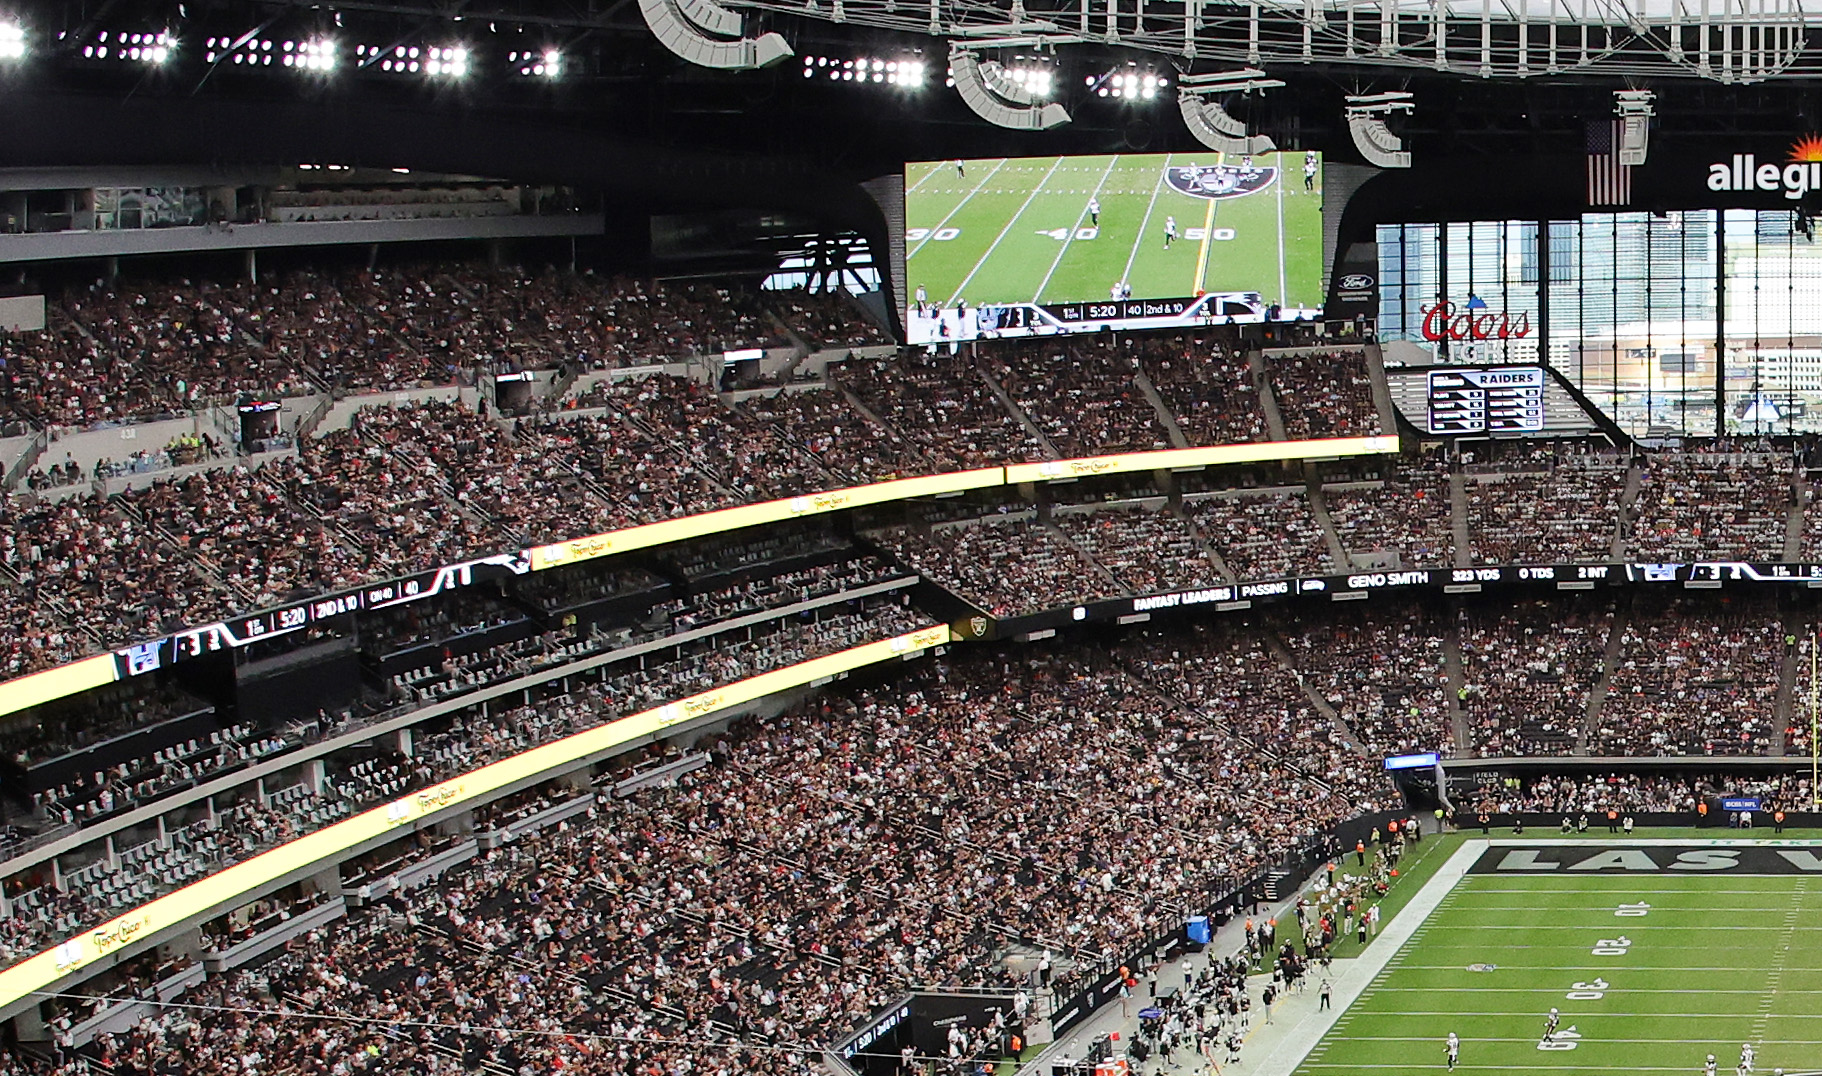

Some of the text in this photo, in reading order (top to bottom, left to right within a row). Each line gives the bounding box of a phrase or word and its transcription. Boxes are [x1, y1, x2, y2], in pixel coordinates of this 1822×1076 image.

[1089, 305, 1117, 318] 5:20
[1128, 305, 1141, 315] 40
[1146, 303, 1184, 314] 2nd & 10
[1420, 300, 1533, 342] Coors
[1432, 342, 1516, 364] LIGHT
[1480, 373, 1534, 384] RAIDERS
[1348, 571, 1429, 589] GENO SMITH
[1452, 568, 1500, 582] 323 YDS
[1530, 568, 1554, 579] TDS
[1578, 567, 1608, 578] 2 INT
[369, 587, 393, 603] ON 40
[404, 580, 419, 595] 40
[1242, 581, 1288, 598] PASSING
[316, 599, 337, 618] 2ND
[344, 595, 358, 611] 10
[1133, 587, 1231, 611] FANTASY LEADERS
[279, 607, 306, 628] 5:20
[1496, 849, 1742, 871] LAS
[1614, 904, 1651, 917] 10
[1591, 939, 1632, 956] 20
[1566, 981, 1609, 1000] 30
